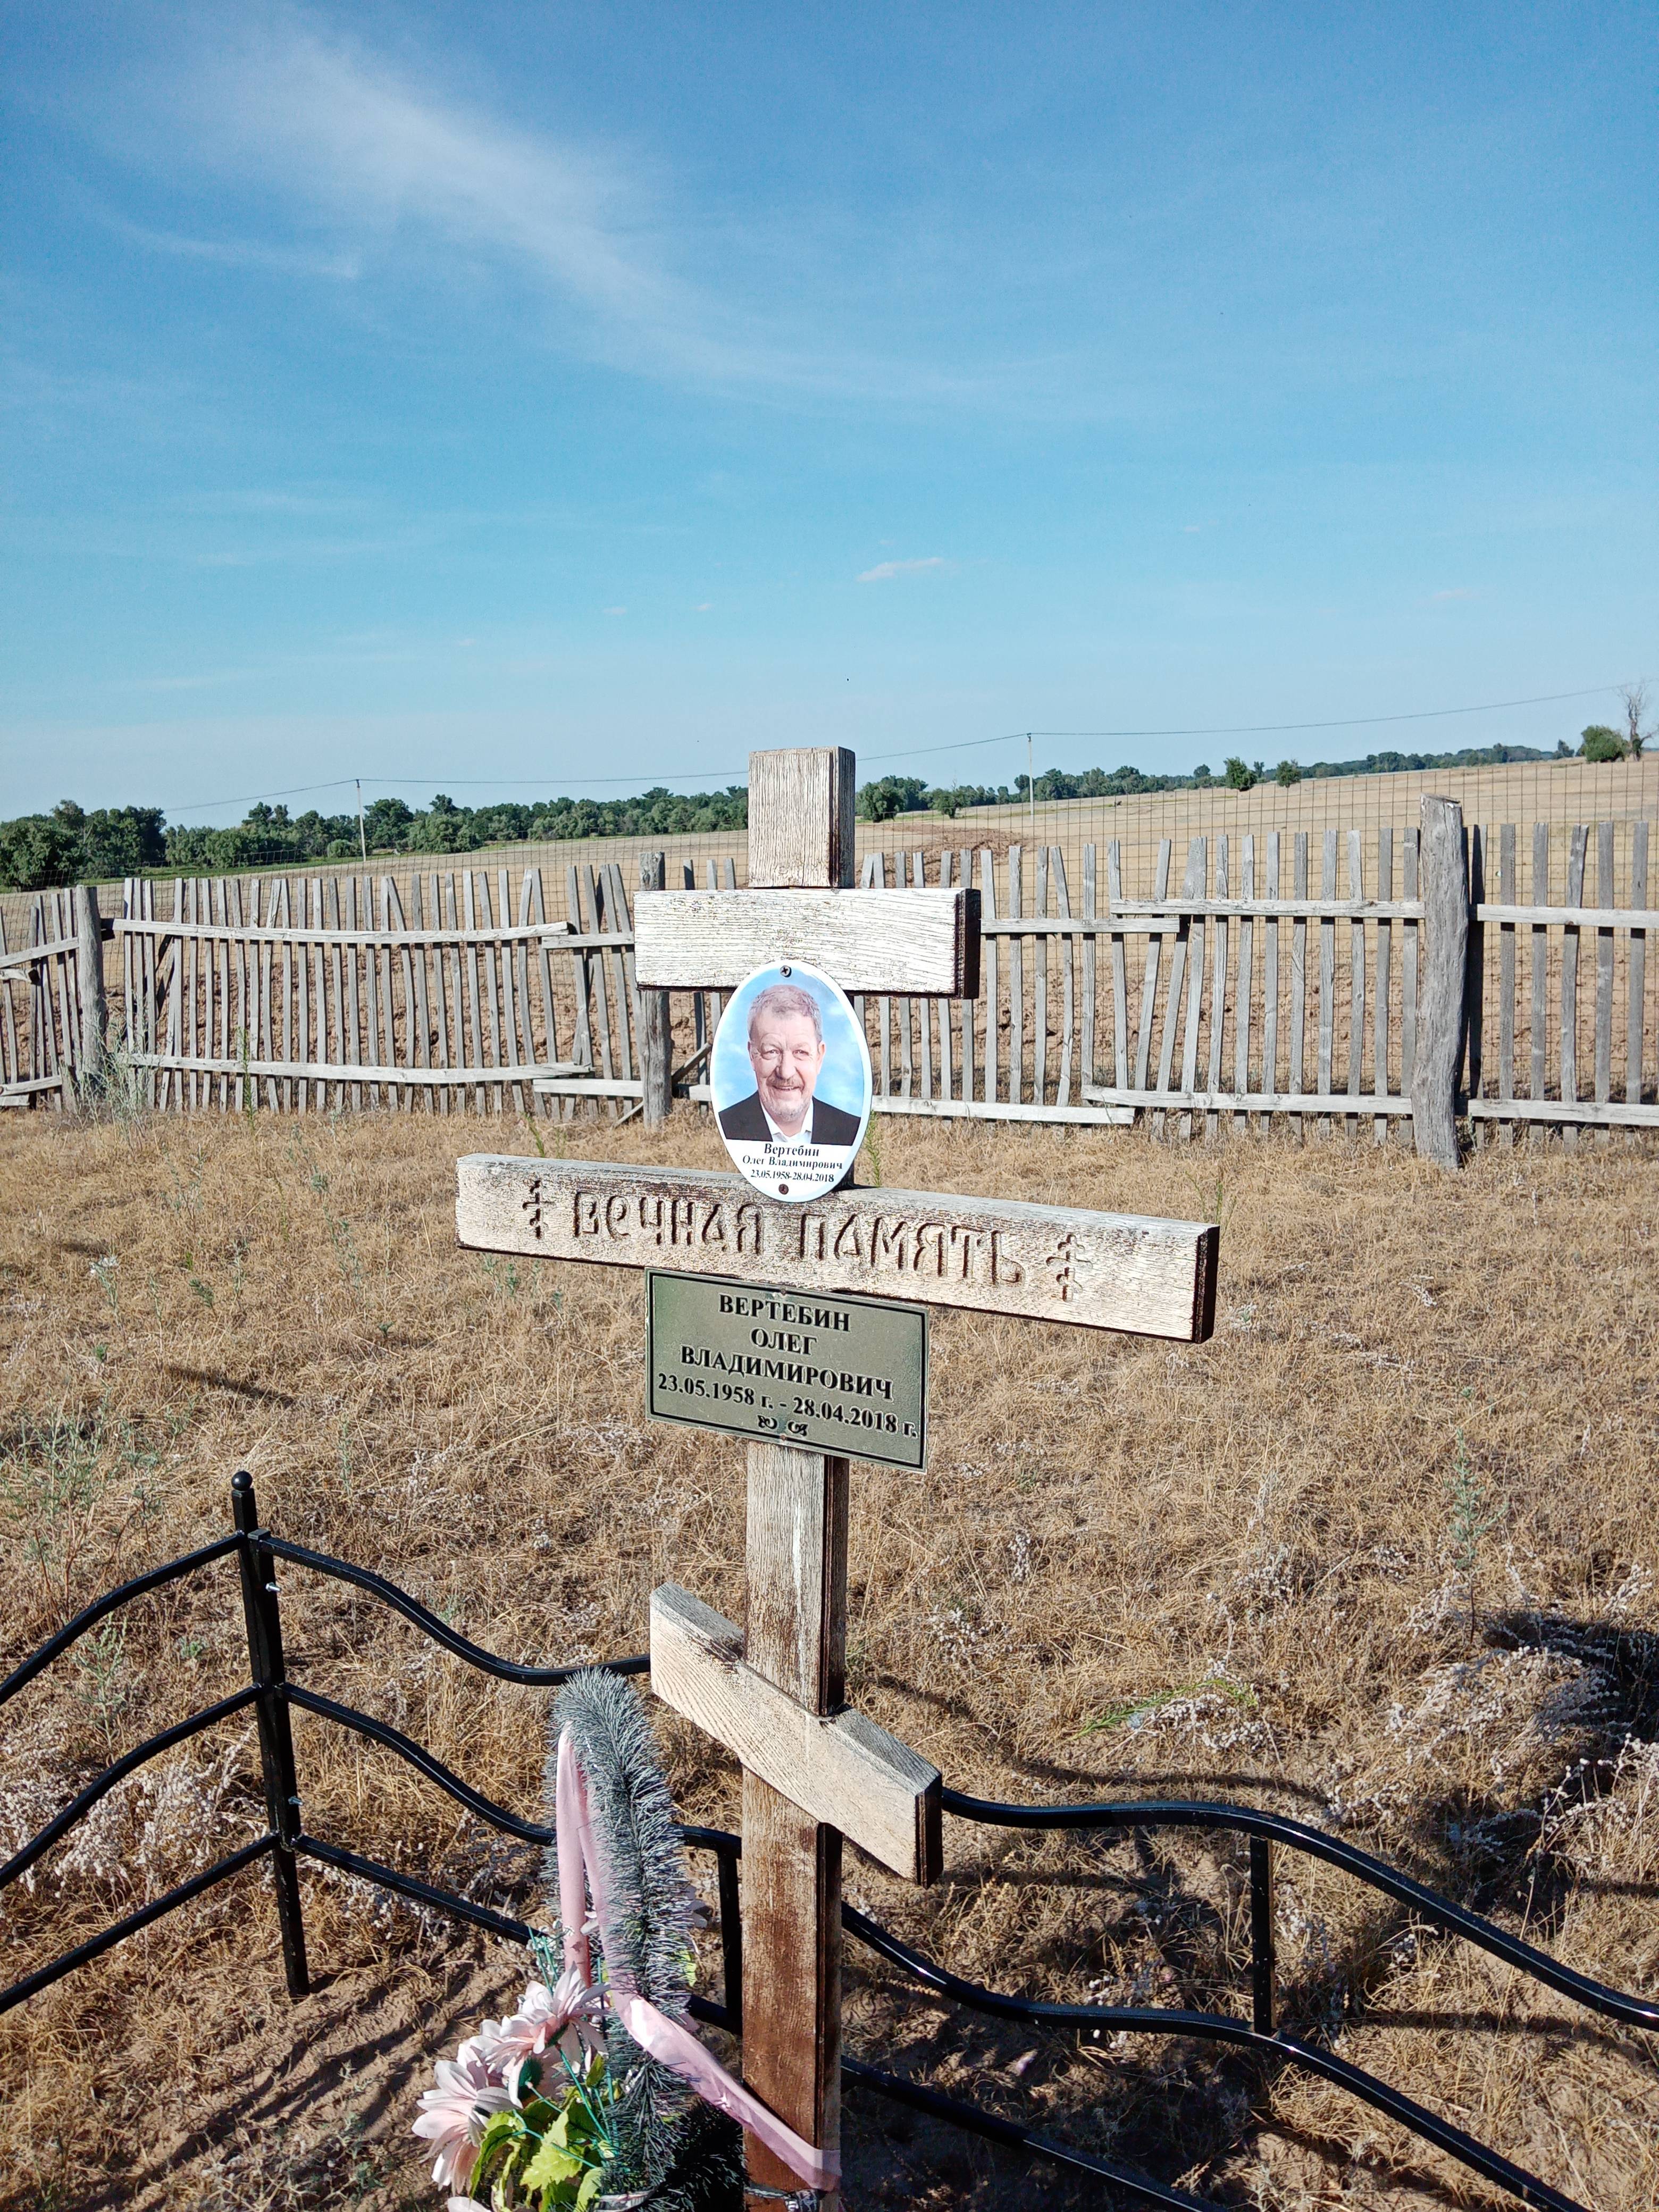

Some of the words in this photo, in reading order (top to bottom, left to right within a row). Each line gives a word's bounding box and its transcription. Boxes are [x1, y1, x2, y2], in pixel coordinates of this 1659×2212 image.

[742, 1155, 764, 1165] Олег
[769, 1157, 843, 1170] Владимирович
[764, 1143, 819, 1157] Вертебин
[750, 1169, 835, 1182] 23.05.1958-28.04.2018
[800, 1213, 1026, 1285] ПАМЯТЬ
[719, 1294, 851, 1332] ВЕРТЕБИН
[750, 1328, 817, 1355] ОЛЕГ
[681, 1345, 893, 1400] ВЛАДИМИРОВИЧ
[658, 1373, 755, 1405] 23.05.1958
[761, 1394, 774, 1410] г.
[793, 1397, 898, 1435] 28.04.2018
[903, 1421, 918, 1438] г.
